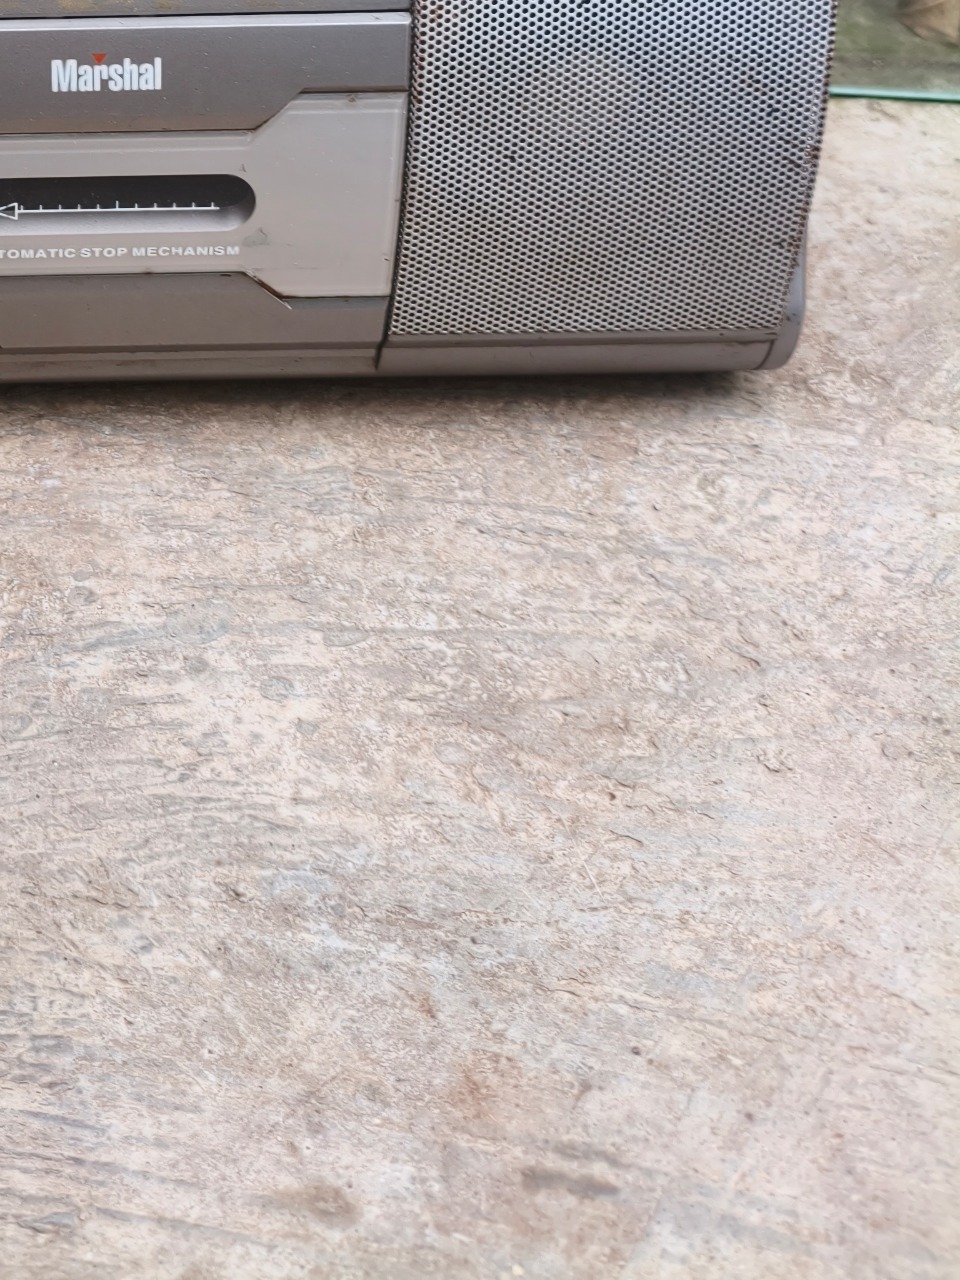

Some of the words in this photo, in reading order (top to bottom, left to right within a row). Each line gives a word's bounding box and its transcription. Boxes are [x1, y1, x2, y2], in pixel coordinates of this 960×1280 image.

[50, 57, 162, 92] Marshal
[80, 247, 128, 258] STOP
[132, 245, 240, 258] MECHANISM
